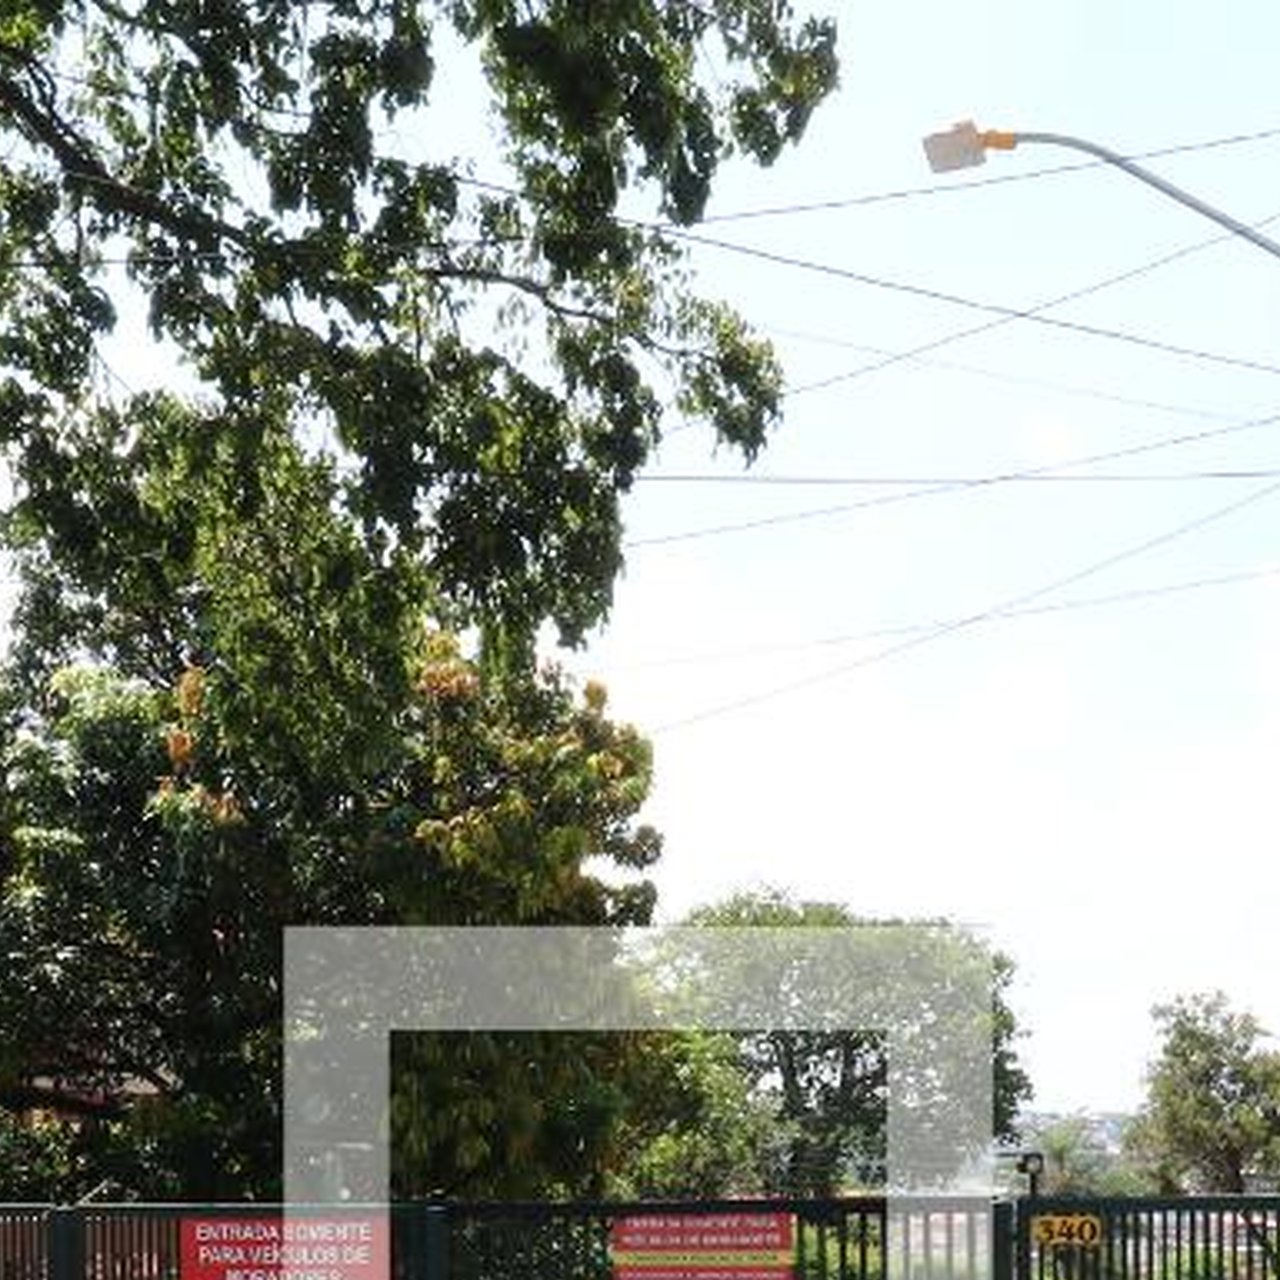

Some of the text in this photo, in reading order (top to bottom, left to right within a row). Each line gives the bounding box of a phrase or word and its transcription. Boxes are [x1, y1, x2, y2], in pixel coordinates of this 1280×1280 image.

[195, 1222, 372, 1242] ENTRADA SOMENTE
[1038, 1218, 1098, 1242] 340
[198, 1246, 248, 1265] PARA
[342, 1246, 371, 1264] DE
